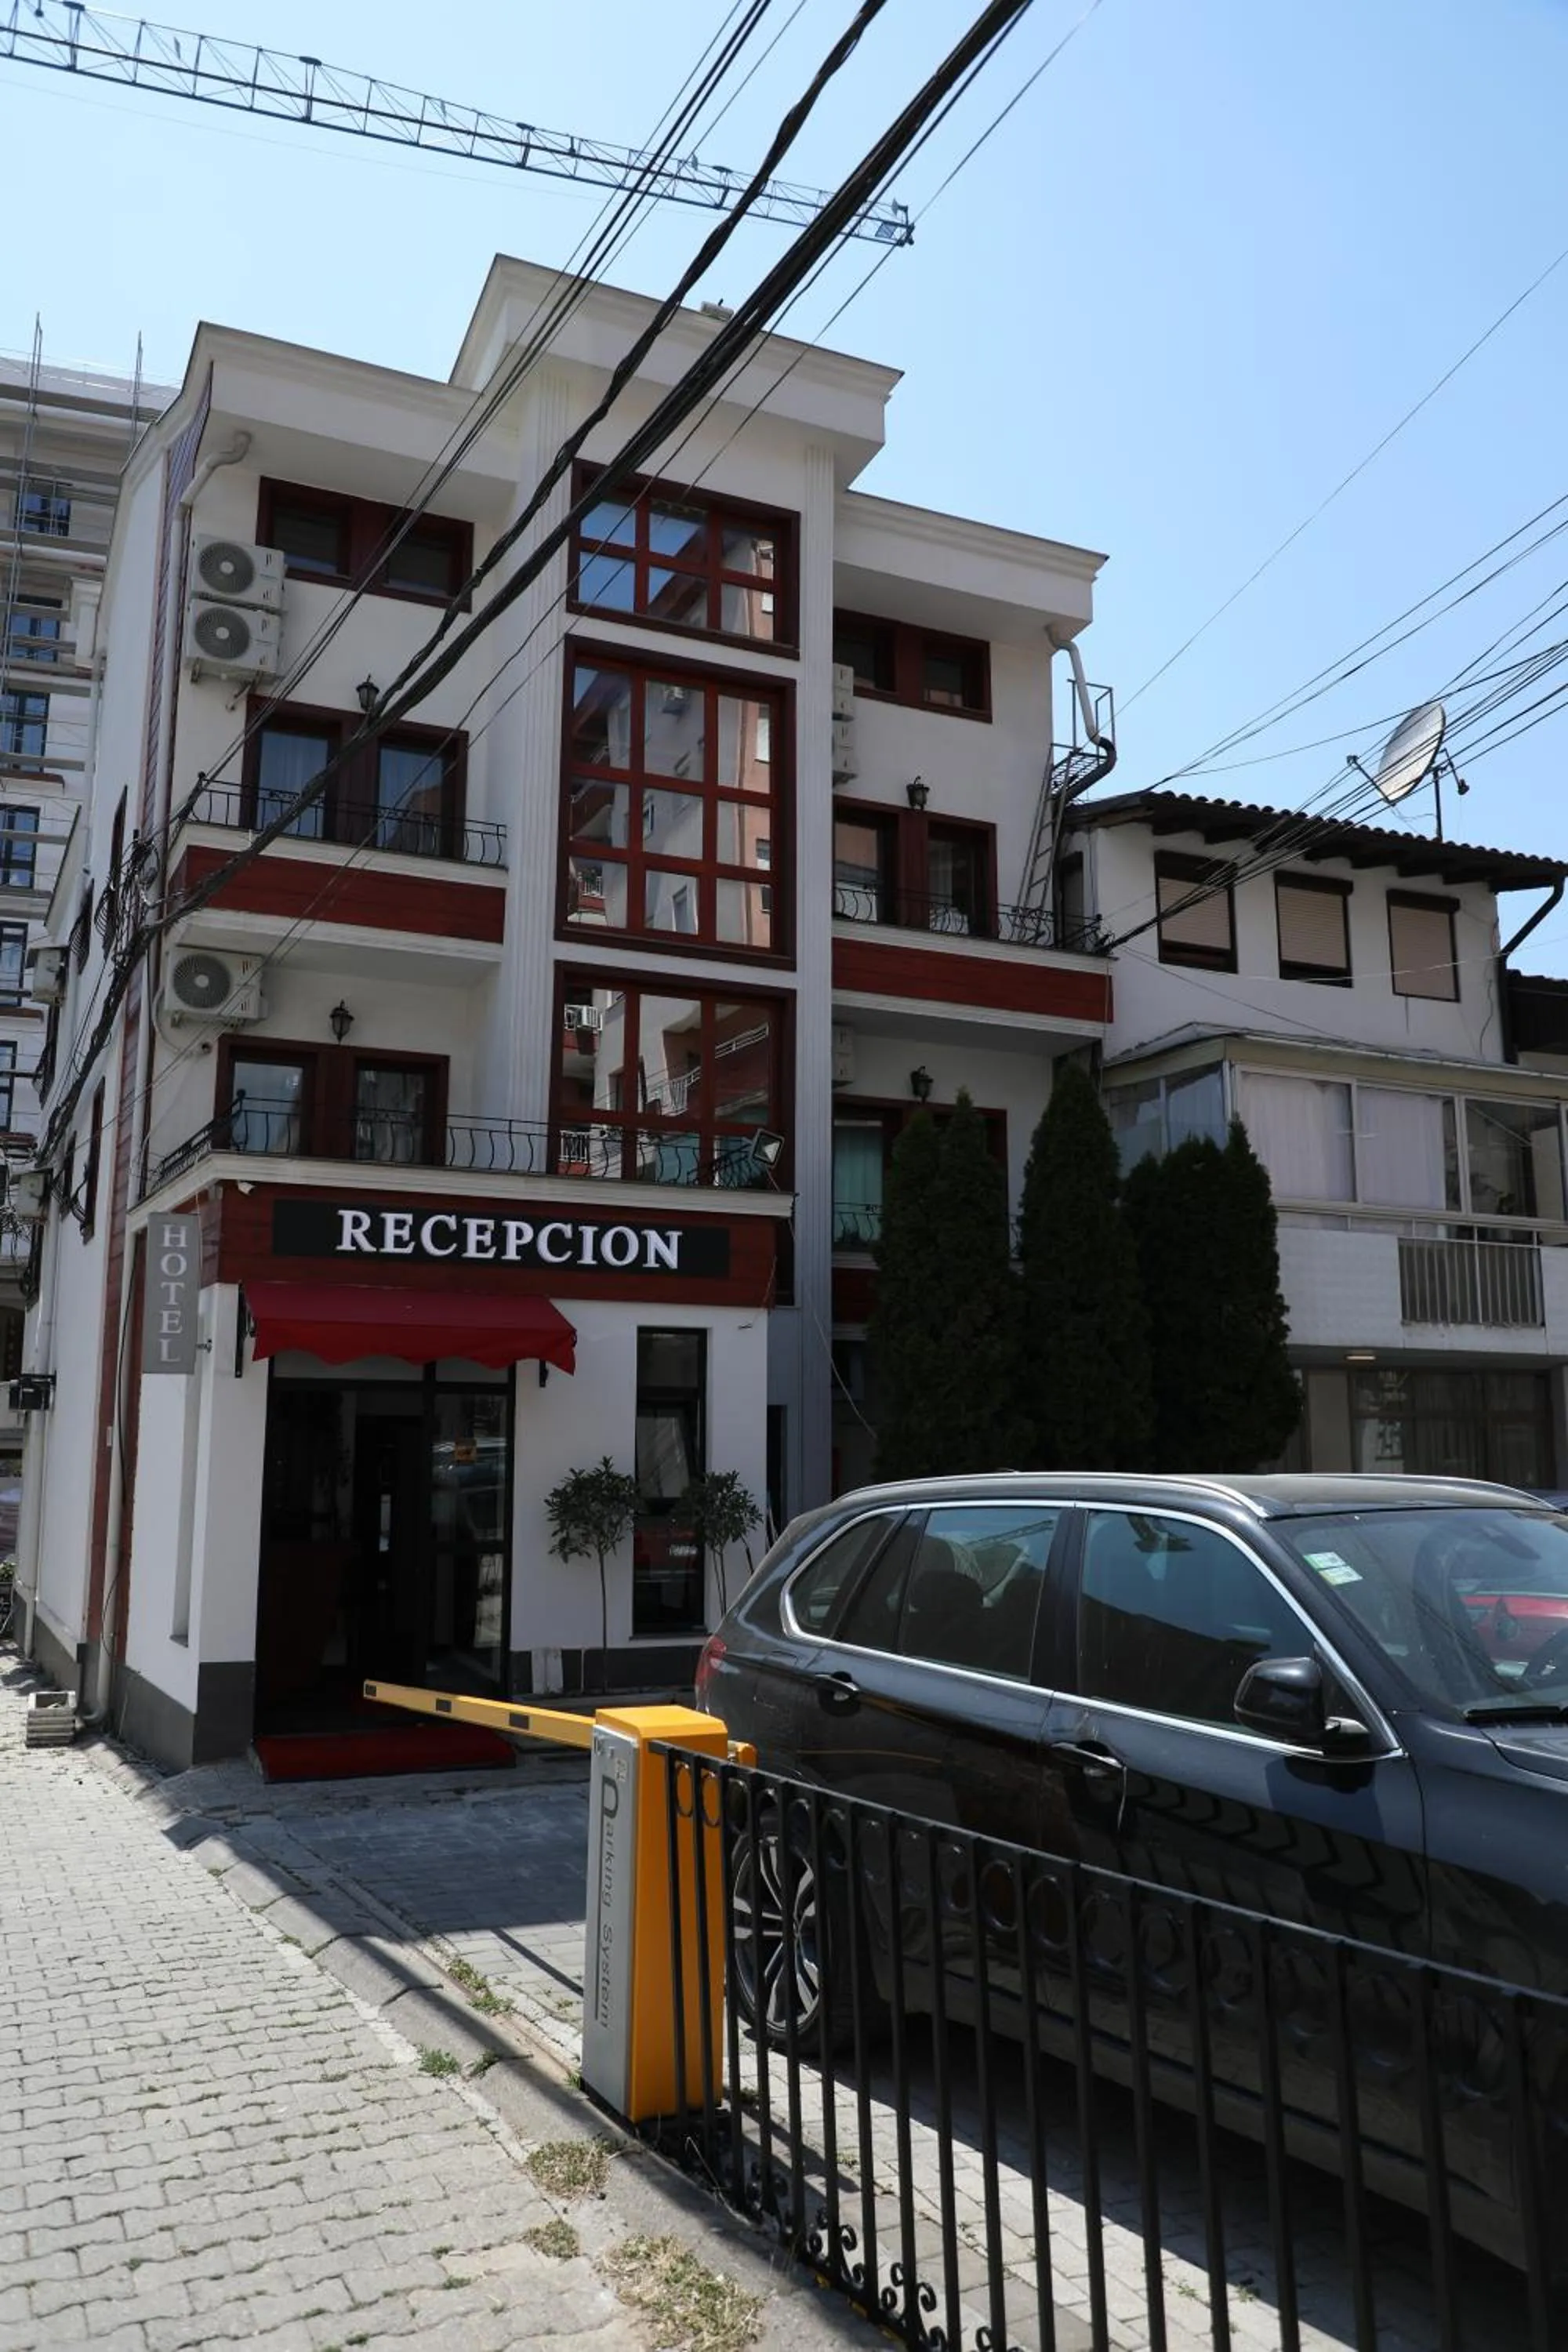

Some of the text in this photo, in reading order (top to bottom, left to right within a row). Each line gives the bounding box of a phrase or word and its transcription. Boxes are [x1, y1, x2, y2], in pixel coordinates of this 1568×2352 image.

[160, 1223, 188, 1363] HOTEL
[336, 1209, 683, 1269] RECEPCION
[599, 1774, 619, 2029] Parking System
